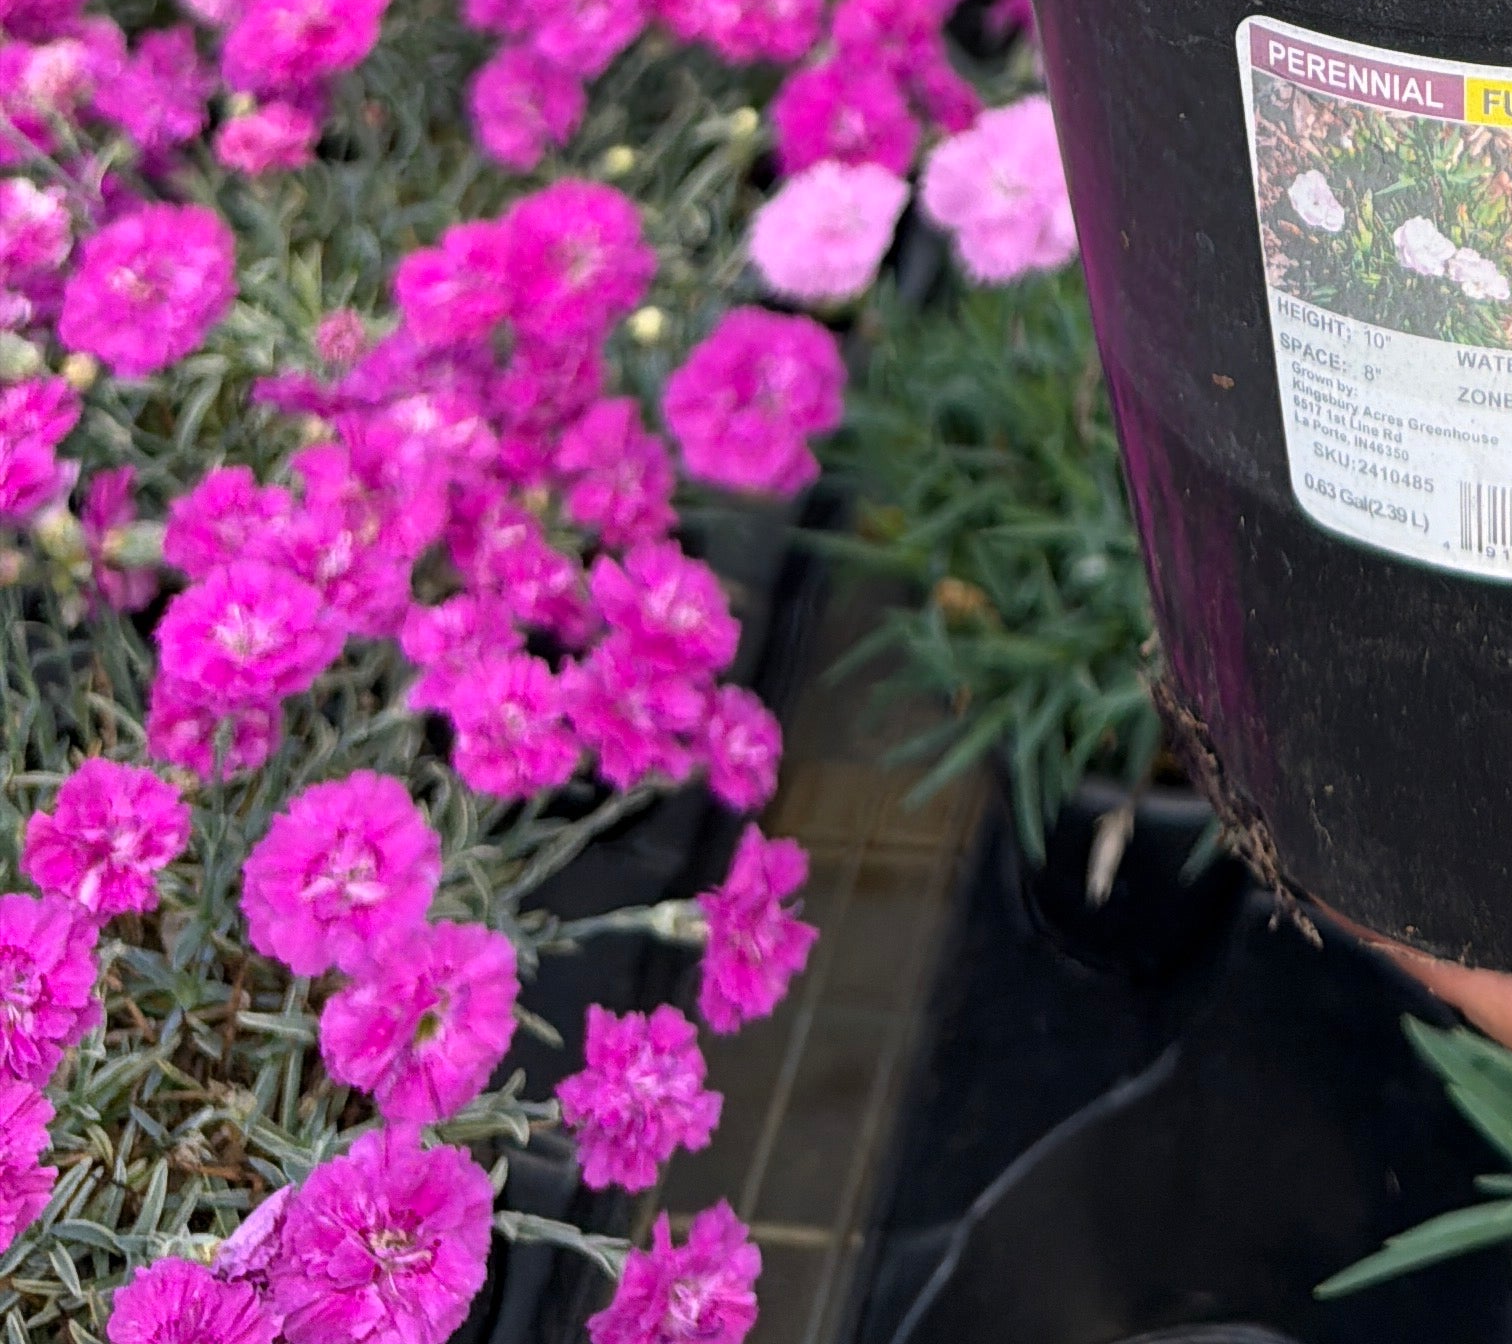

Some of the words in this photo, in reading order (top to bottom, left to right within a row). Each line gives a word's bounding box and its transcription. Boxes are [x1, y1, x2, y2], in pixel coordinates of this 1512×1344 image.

[1268, 39, 1444, 109] PERENNIAL
[1277, 296, 1352, 341] HEIGHT:
[1364, 330, 1391, 349] 10"
[1279, 332, 1347, 372] SPACE:
[1364, 365, 1382, 381] 8"
[1291, 361, 1334, 387] Grown
[1337, 378, 1359, 397] by:
[1292, 377, 1359, 416] Kingsbury
[1363, 406, 1404, 428] Acres
[1408, 417, 1499, 446] Greenhouse
[1293, 395, 1322, 416] 6517
[1326, 409, 1347, 425] 1st
[1350, 418, 1380, 438] Line
[1383, 428, 1403, 444] Rd
[1294, 409, 1310, 426] La
[1313, 419, 1350, 445] Porte,
[1304, 472, 1337, 499] 0.63
